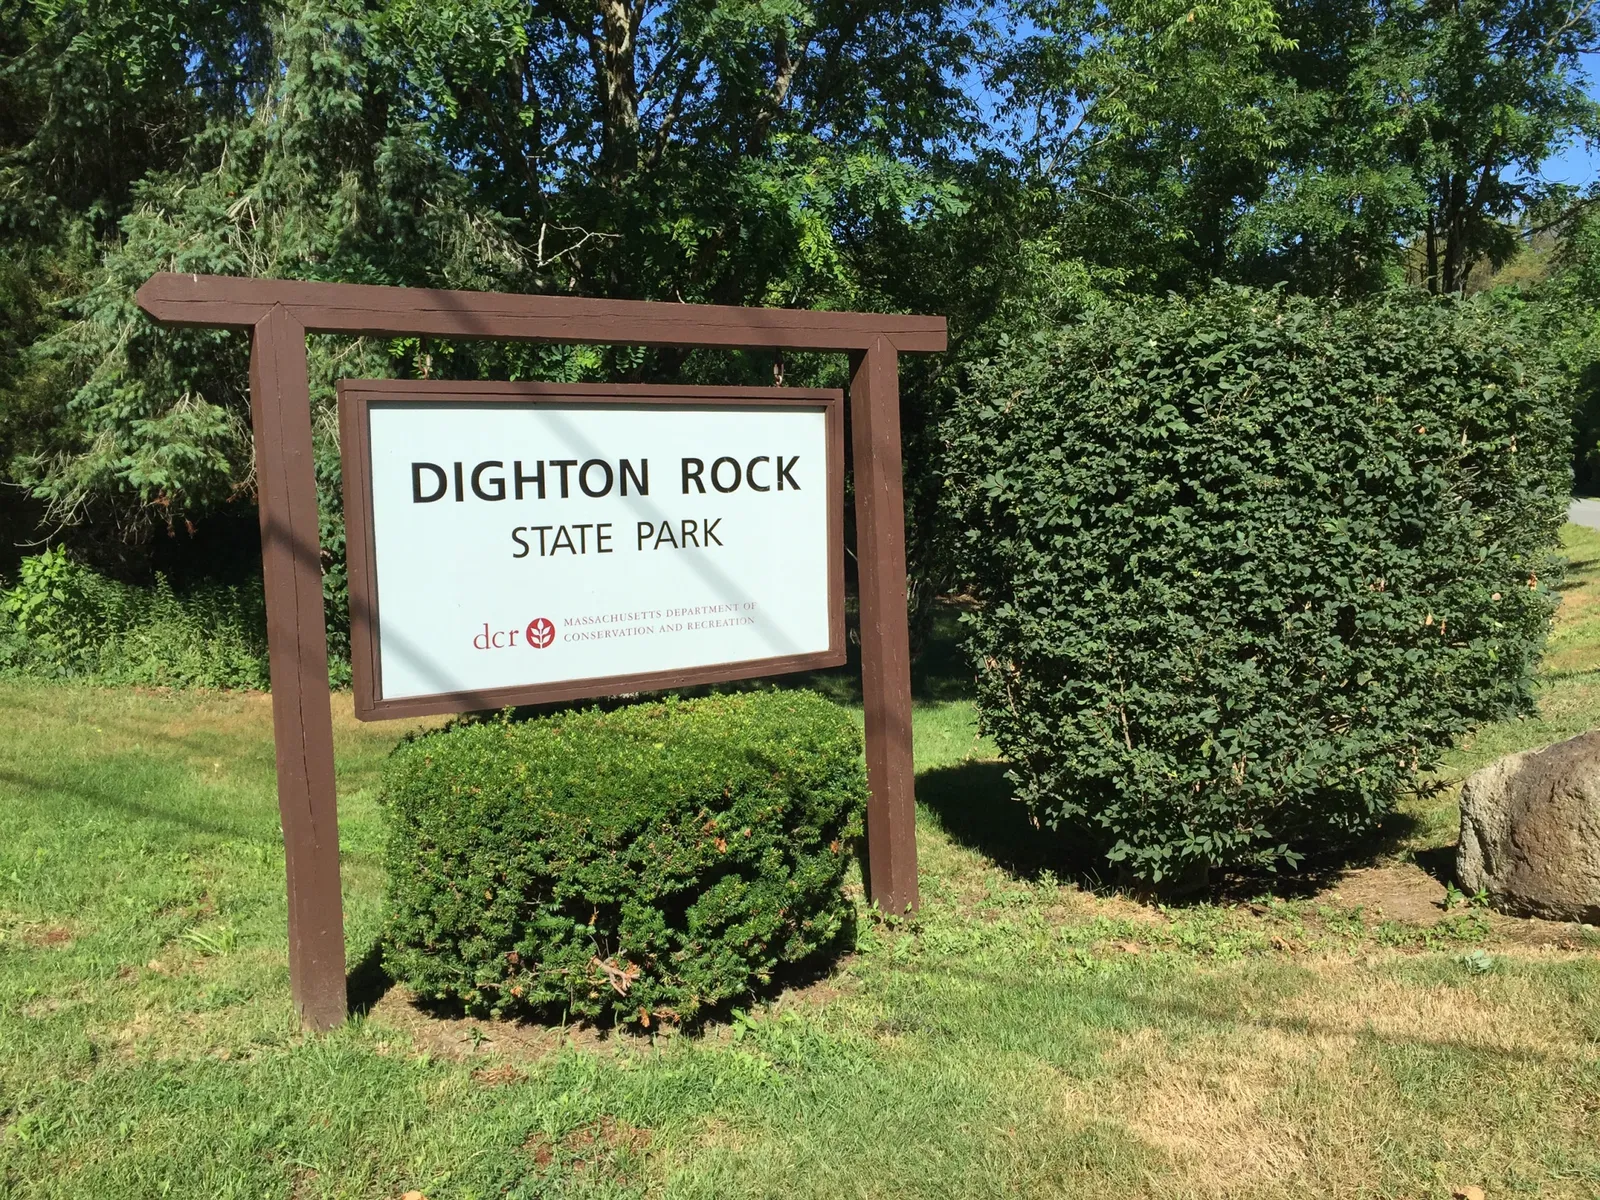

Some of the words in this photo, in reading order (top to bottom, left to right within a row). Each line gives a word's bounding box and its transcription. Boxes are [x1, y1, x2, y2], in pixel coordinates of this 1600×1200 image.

[411, 458, 649, 503] DIGHTON
[681, 455, 801, 494] ROCK
[511, 523, 613, 559] STATE
[637, 517, 724, 551] PARK
[564, 610, 662, 627] MASSACHUSETTS
[665, 603, 740, 618] DEPARTMENT
[743, 601, 757, 611] OF
[473, 623, 519, 650] dcr
[564, 625, 655, 643] CONSERVATION
[659, 623, 683, 633] AND
[687, 616, 755, 631] RECREATION
